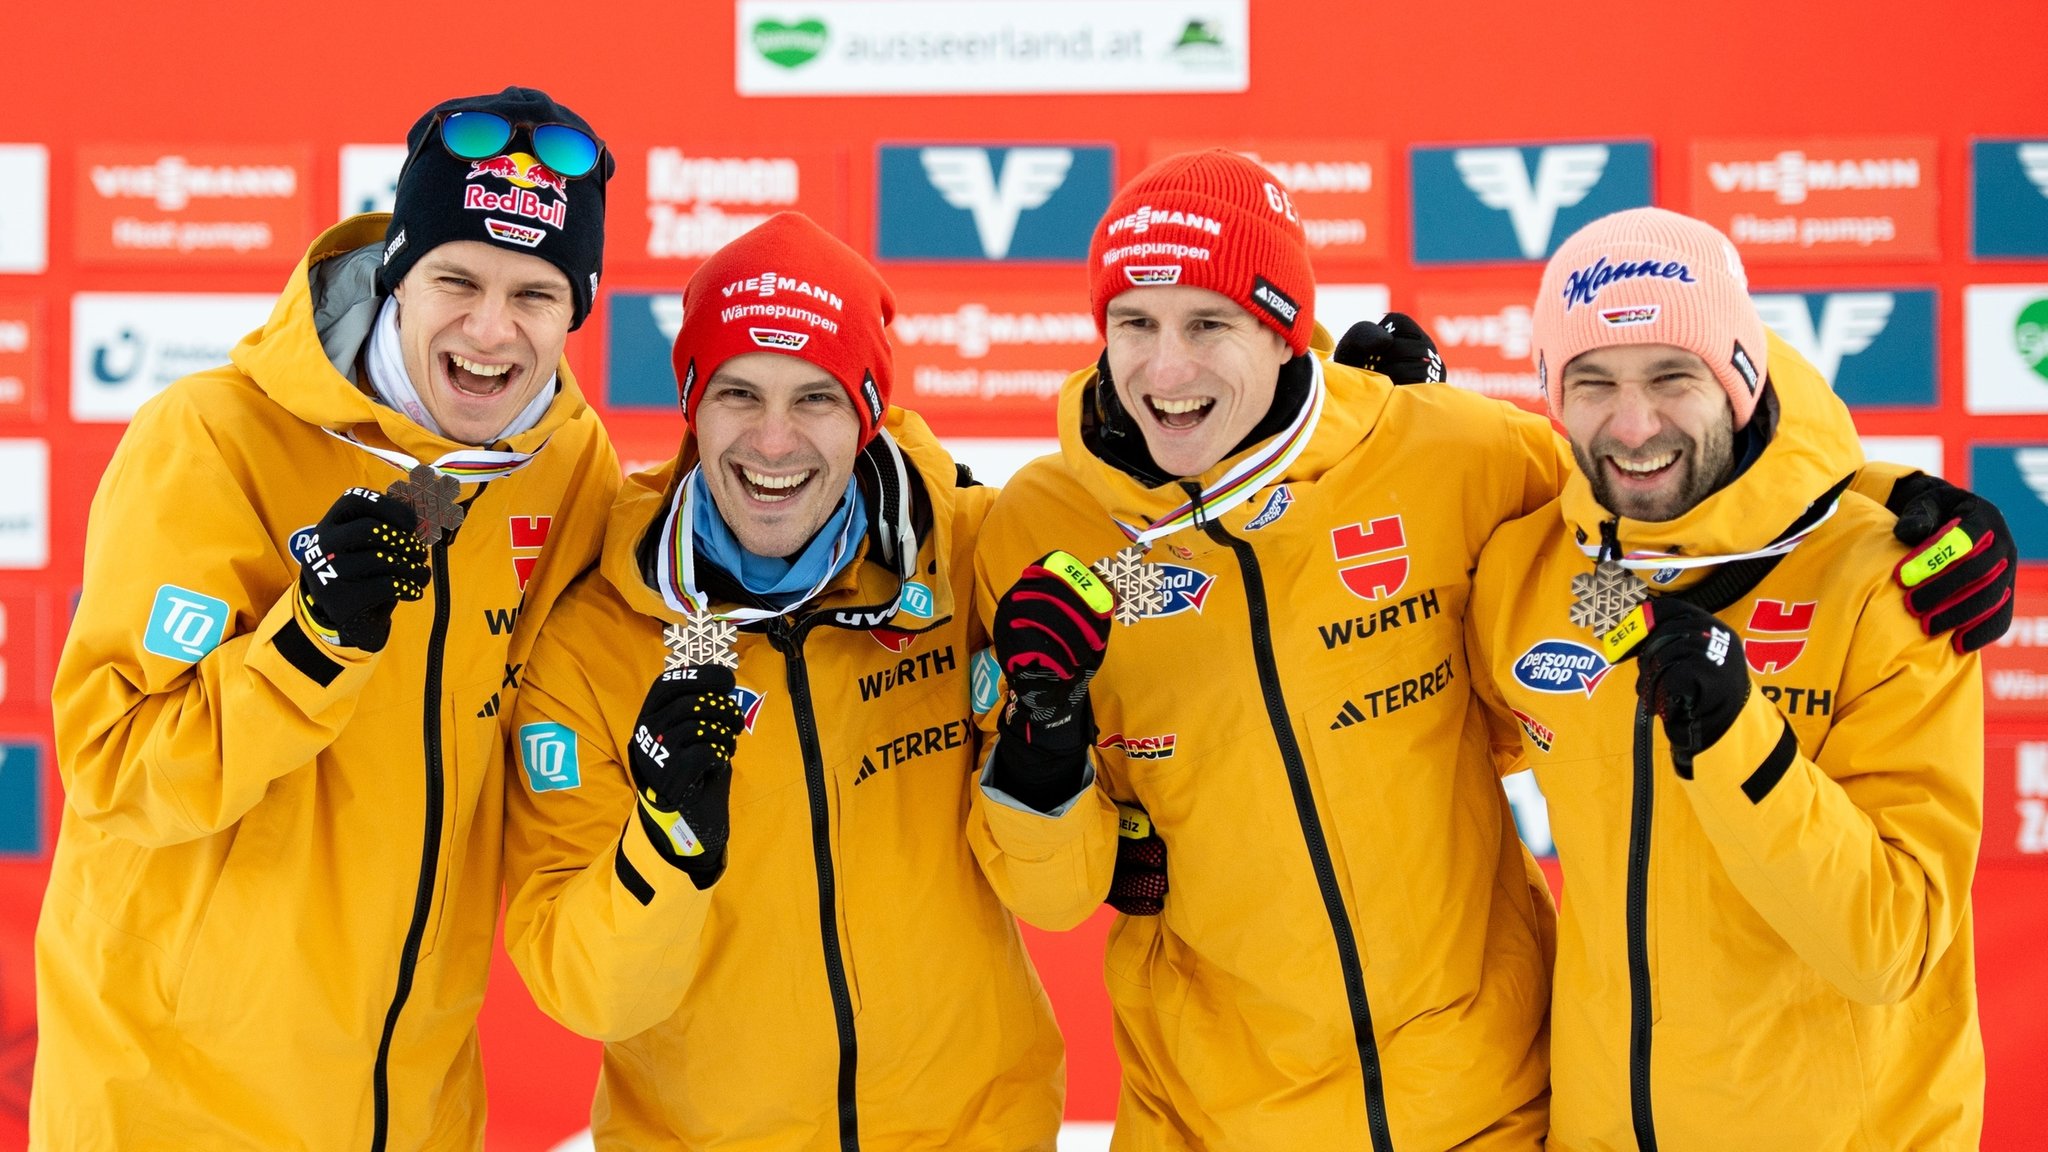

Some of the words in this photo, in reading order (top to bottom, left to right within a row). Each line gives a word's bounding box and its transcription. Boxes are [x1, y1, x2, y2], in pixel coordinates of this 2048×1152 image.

[464, 184, 519, 214] Red
[519, 190, 567, 231] Bull
[1107, 205, 1222, 235] VIESSMANN
[1264, 182, 1299, 227] GE
[511, 226, 543, 246] DSV
[1102, 242, 1210, 267] Wärmepumpen
[1150, 269, 1177, 282] DSV
[1562, 255, 1697, 312] Manner
[721, 272, 843, 311] VIESSMANN
[1267, 290, 1298, 323] TERREX
[720, 303, 839, 335] Wärmepumpen
[1627, 307, 1656, 323] DSV
[776, 332, 803, 347] DSV
[344, 487, 380, 503] SEIZ
[304, 533, 339, 586] SEIZ
[1927, 544, 1956, 572] SEIZ
[1064, 564, 1094, 592] SEIZ
[905, 585, 929, 615] TQ
[160, 597, 215, 657] TQ
[1318, 588, 1441, 650] WÜRTH
[1610, 621, 1638, 647] SEIZ
[1520, 652, 1597, 671] personal
[1703, 626, 1730, 667] SEIZ
[662, 667, 698, 682] SEIZ
[1364, 653, 1454, 718] TERREX
[1530, 666, 1573, 685] shop
[525, 732, 568, 782] TQ
[635, 725, 670, 769] SEIZ
[876, 717, 973, 769] TERREX
